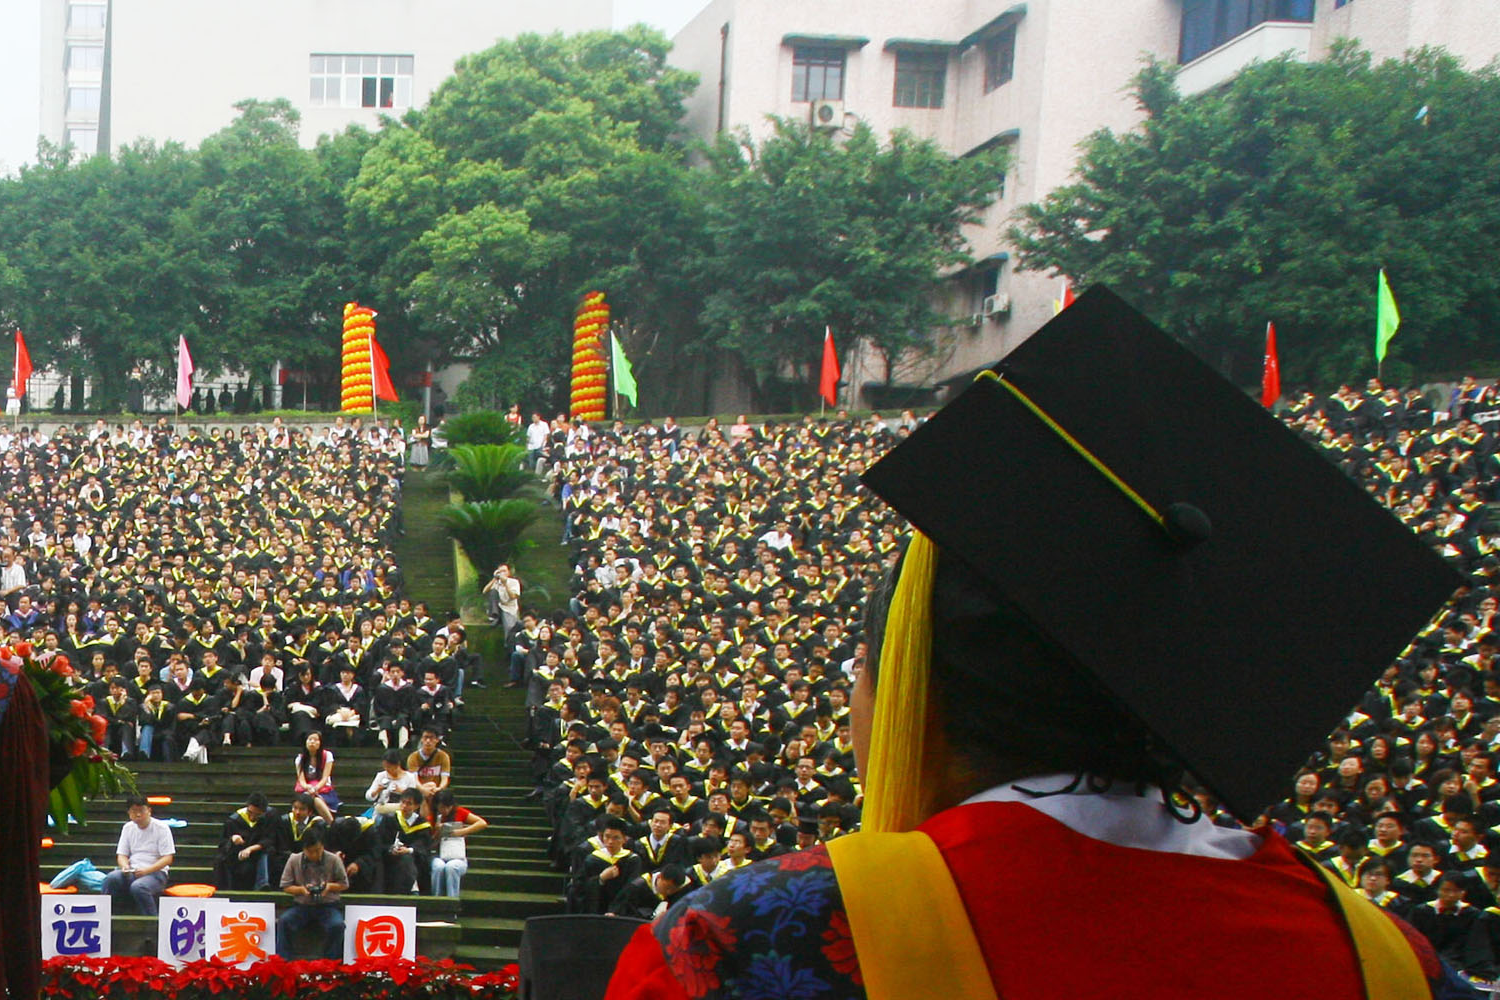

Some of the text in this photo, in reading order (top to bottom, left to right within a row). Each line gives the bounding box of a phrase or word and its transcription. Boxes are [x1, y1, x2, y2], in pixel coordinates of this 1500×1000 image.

[52, 904, 405, 962] 远 的 家 园
